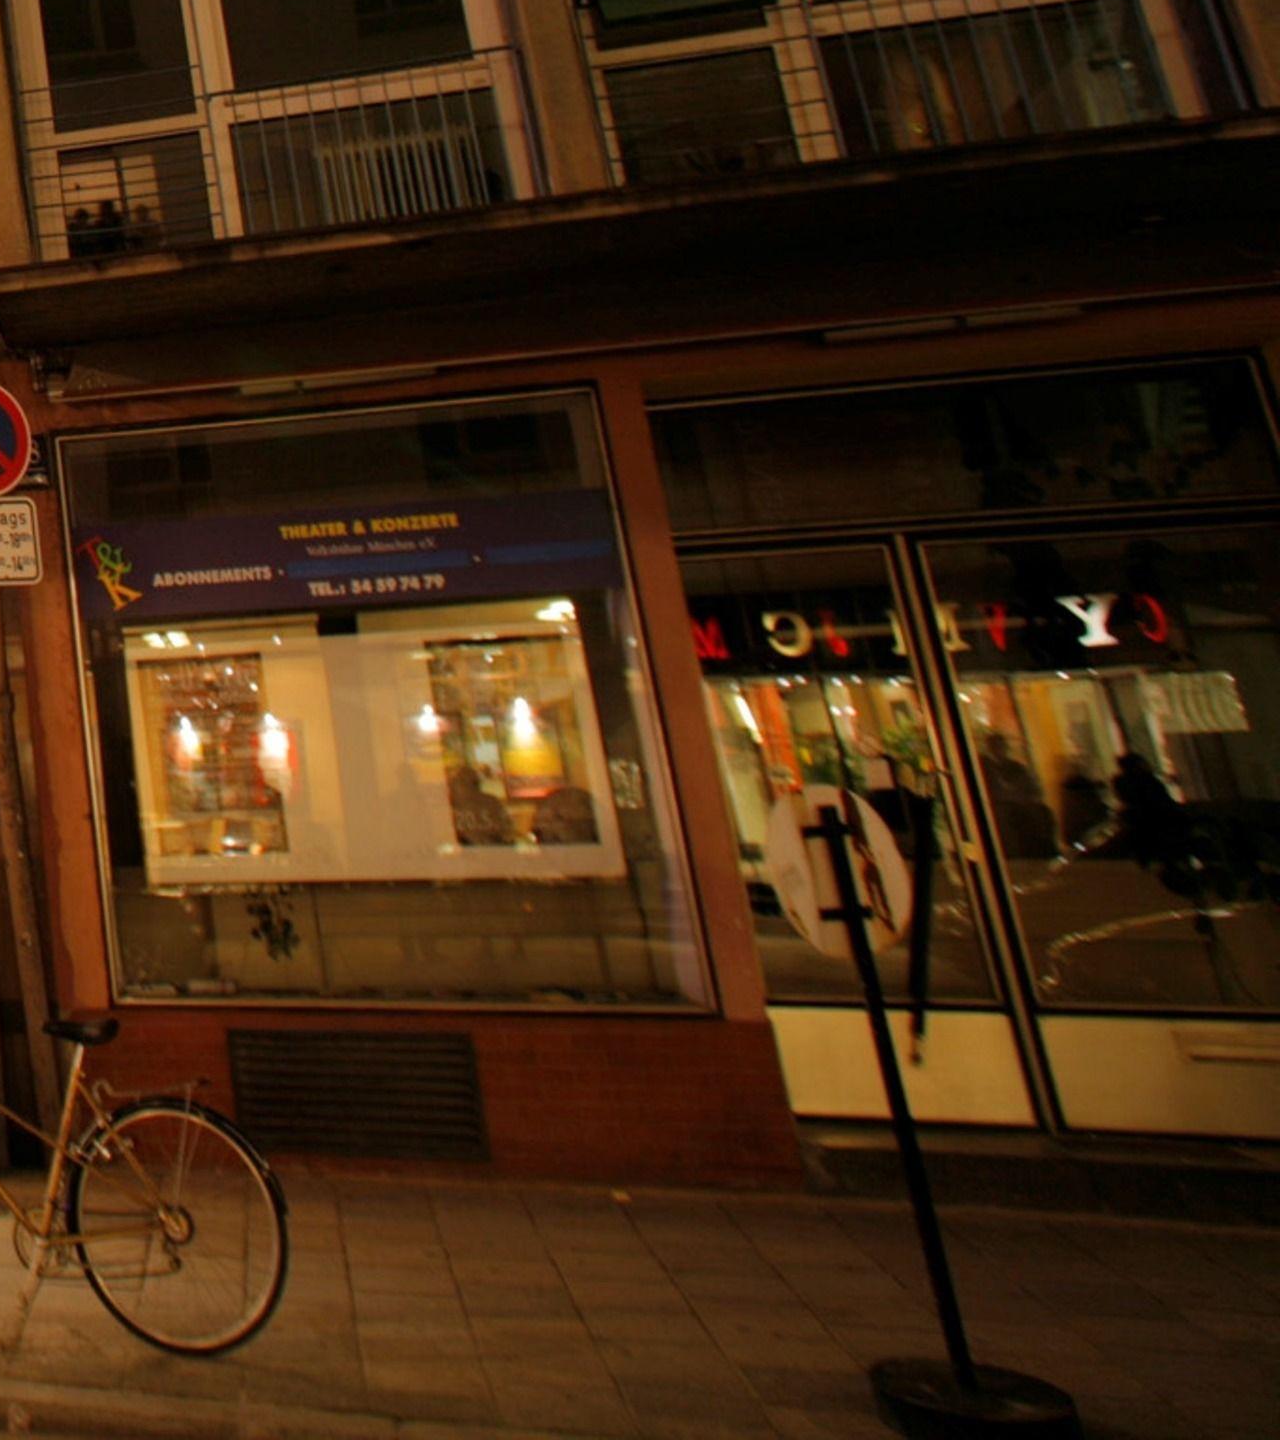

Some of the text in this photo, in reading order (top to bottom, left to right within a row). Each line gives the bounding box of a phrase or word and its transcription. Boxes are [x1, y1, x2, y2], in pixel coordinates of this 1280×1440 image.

[278, 513, 460, 541] THEATER & KONZERTE
[152, 566, 272, 588] ABONNEMENTS
